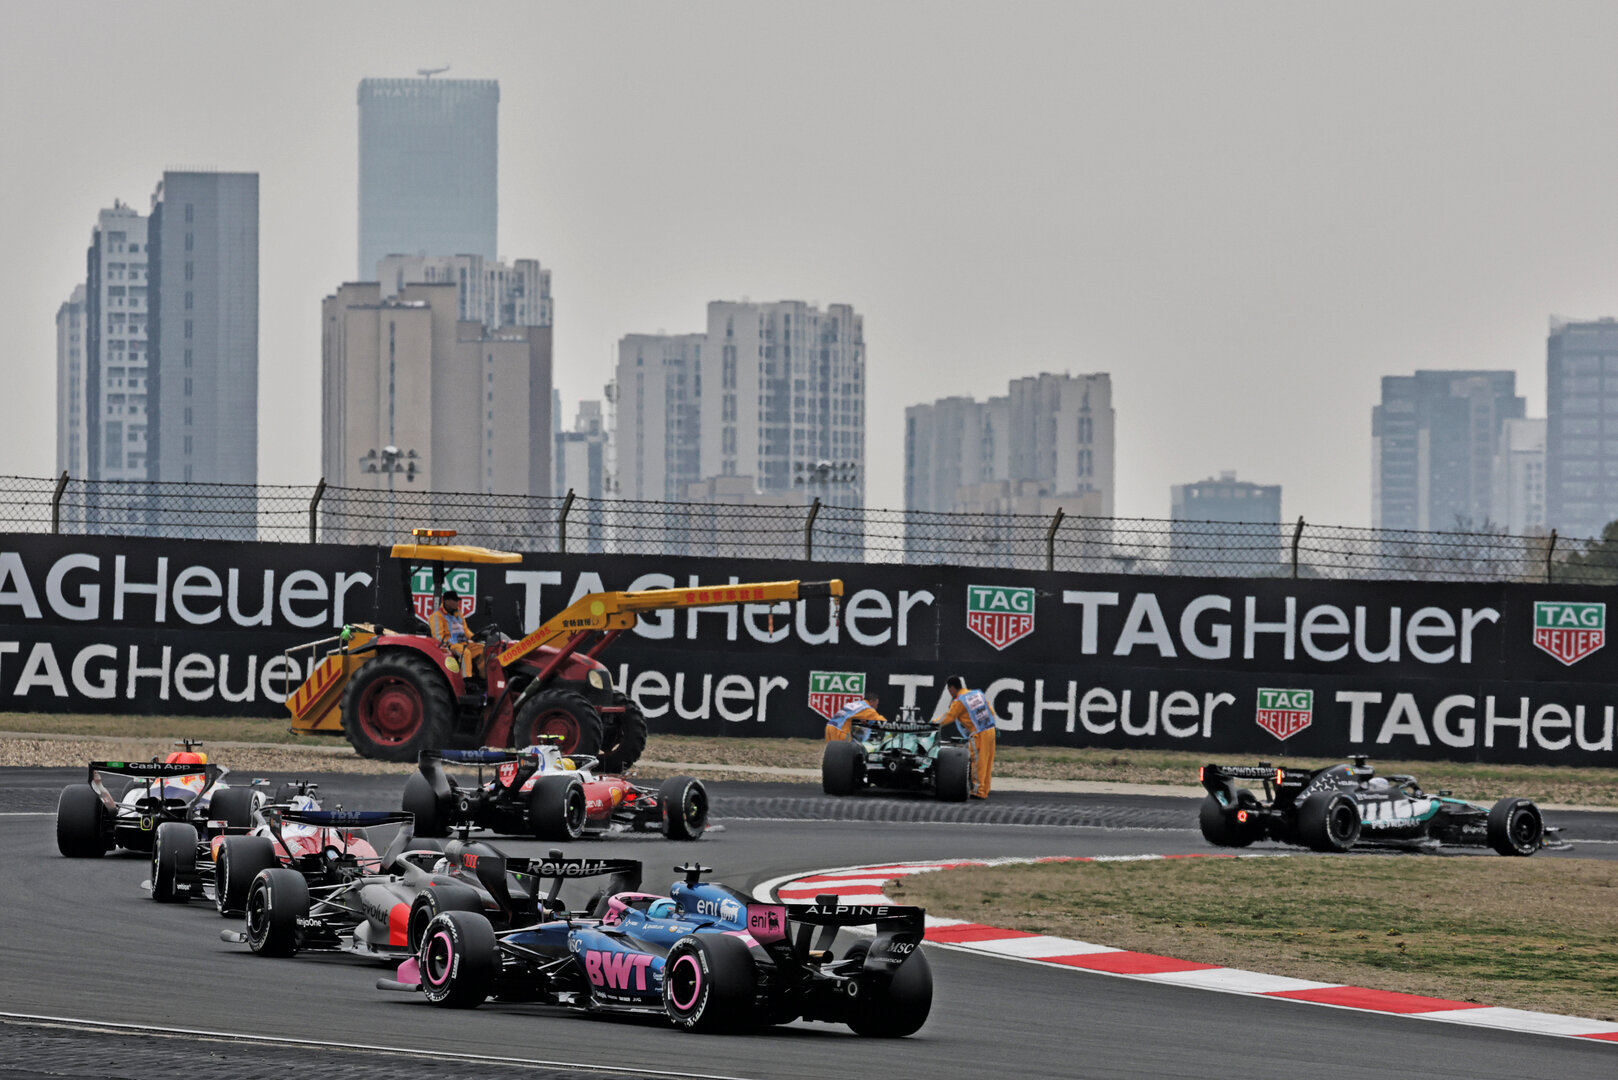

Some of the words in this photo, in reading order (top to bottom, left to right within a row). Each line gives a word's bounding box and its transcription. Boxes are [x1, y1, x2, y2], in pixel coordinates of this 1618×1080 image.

[973, 589, 1028, 611] TAG
[1540, 606, 1600, 626] TAG
[970, 613, 1031, 646] HEUER
[1537, 629, 1601, 661] HEUER
[814, 674, 860, 692] TAG
[1262, 692, 1308, 709] TAG
[1259, 710, 1309, 739] HEUER
[1335, 691, 1618, 752] TAGHeu
[128, 762, 161, 770] Cash
[163, 763, 191, 771] App
[526, 858, 607, 876] Revolut
[362, 902, 388, 925] evolut
[696, 897, 721, 917] eni
[805, 905, 889, 916] ALPINE
[751, 911, 768, 929] eni
[887, 942, 915, 954] MSC
[585, 949, 655, 991] BWT
